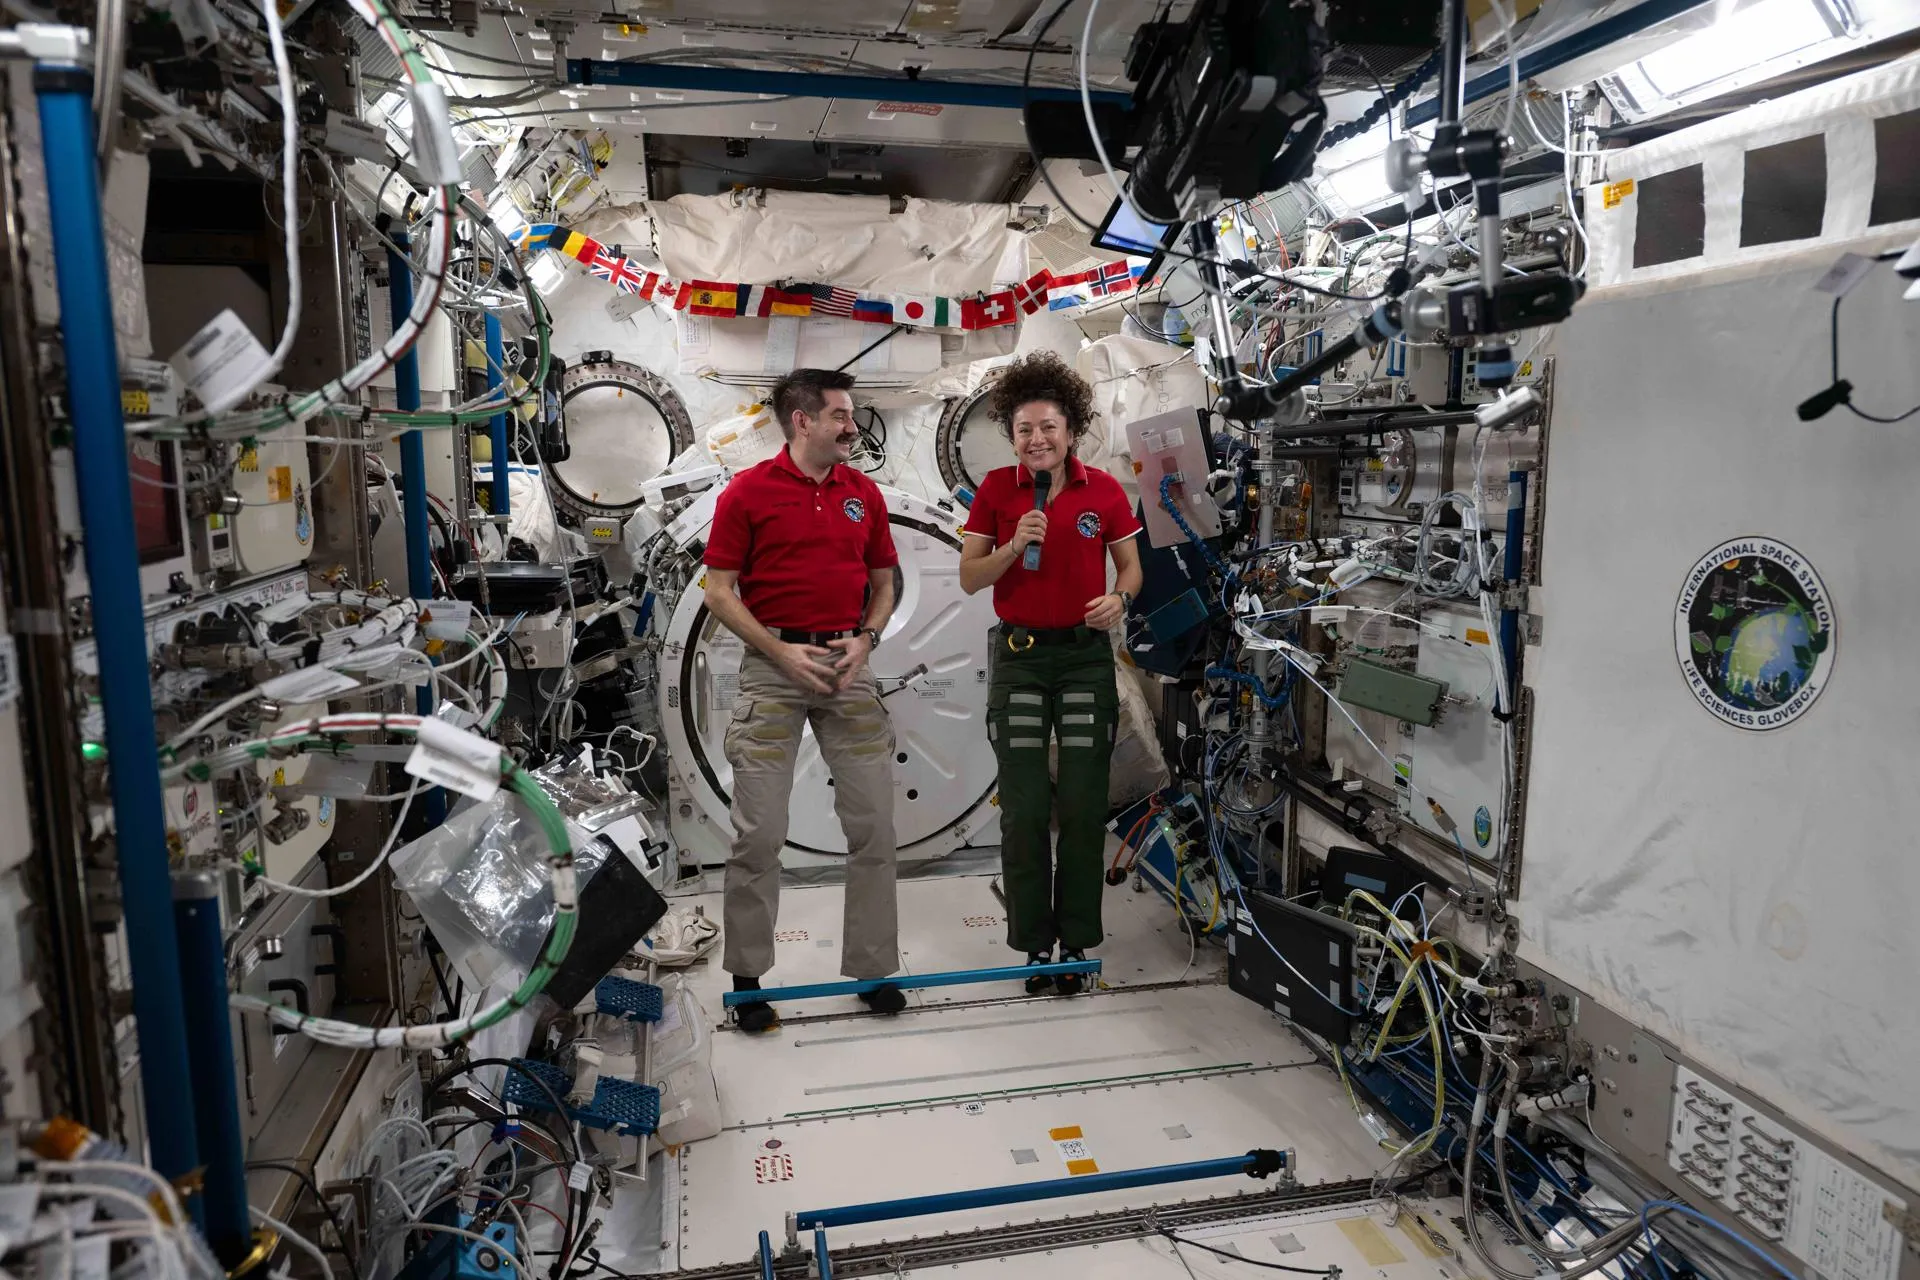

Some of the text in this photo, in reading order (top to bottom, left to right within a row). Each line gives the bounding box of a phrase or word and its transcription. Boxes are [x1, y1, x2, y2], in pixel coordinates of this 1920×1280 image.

[1680, 543, 1830, 633] INTERNATIONAL SPACE STATION
[1683, 659, 1818, 726] LIFE SCIENCES GLOVEBOX
